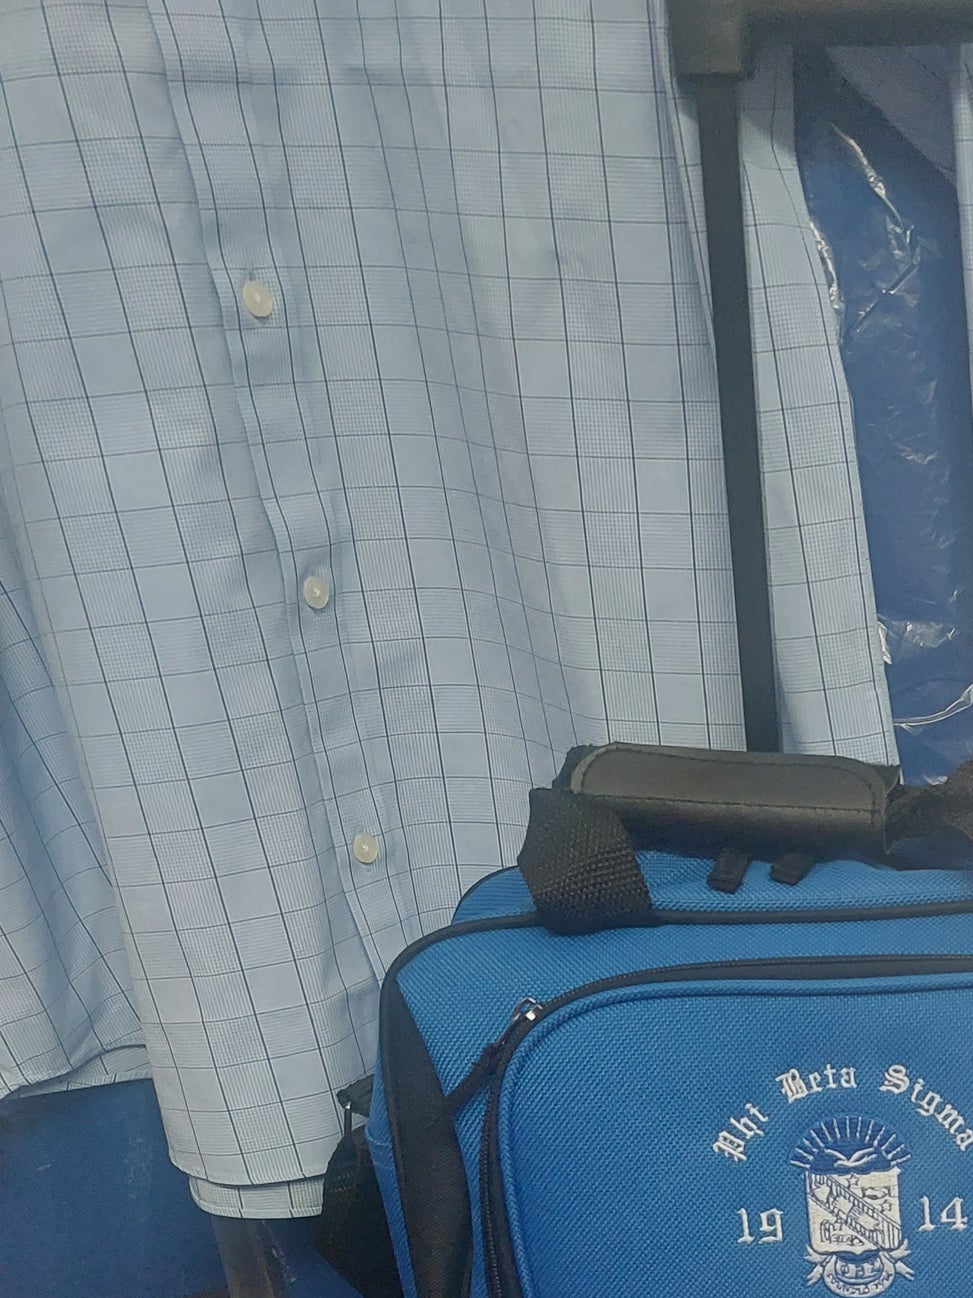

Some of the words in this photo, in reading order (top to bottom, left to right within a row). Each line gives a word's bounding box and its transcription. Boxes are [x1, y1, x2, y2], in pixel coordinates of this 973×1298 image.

[713, 1103, 769, 1162] Phi
[775, 1063, 858, 1104] Beta
[736, 1207, 784, 1244] 19
[918, 1195, 968, 1232] 14
